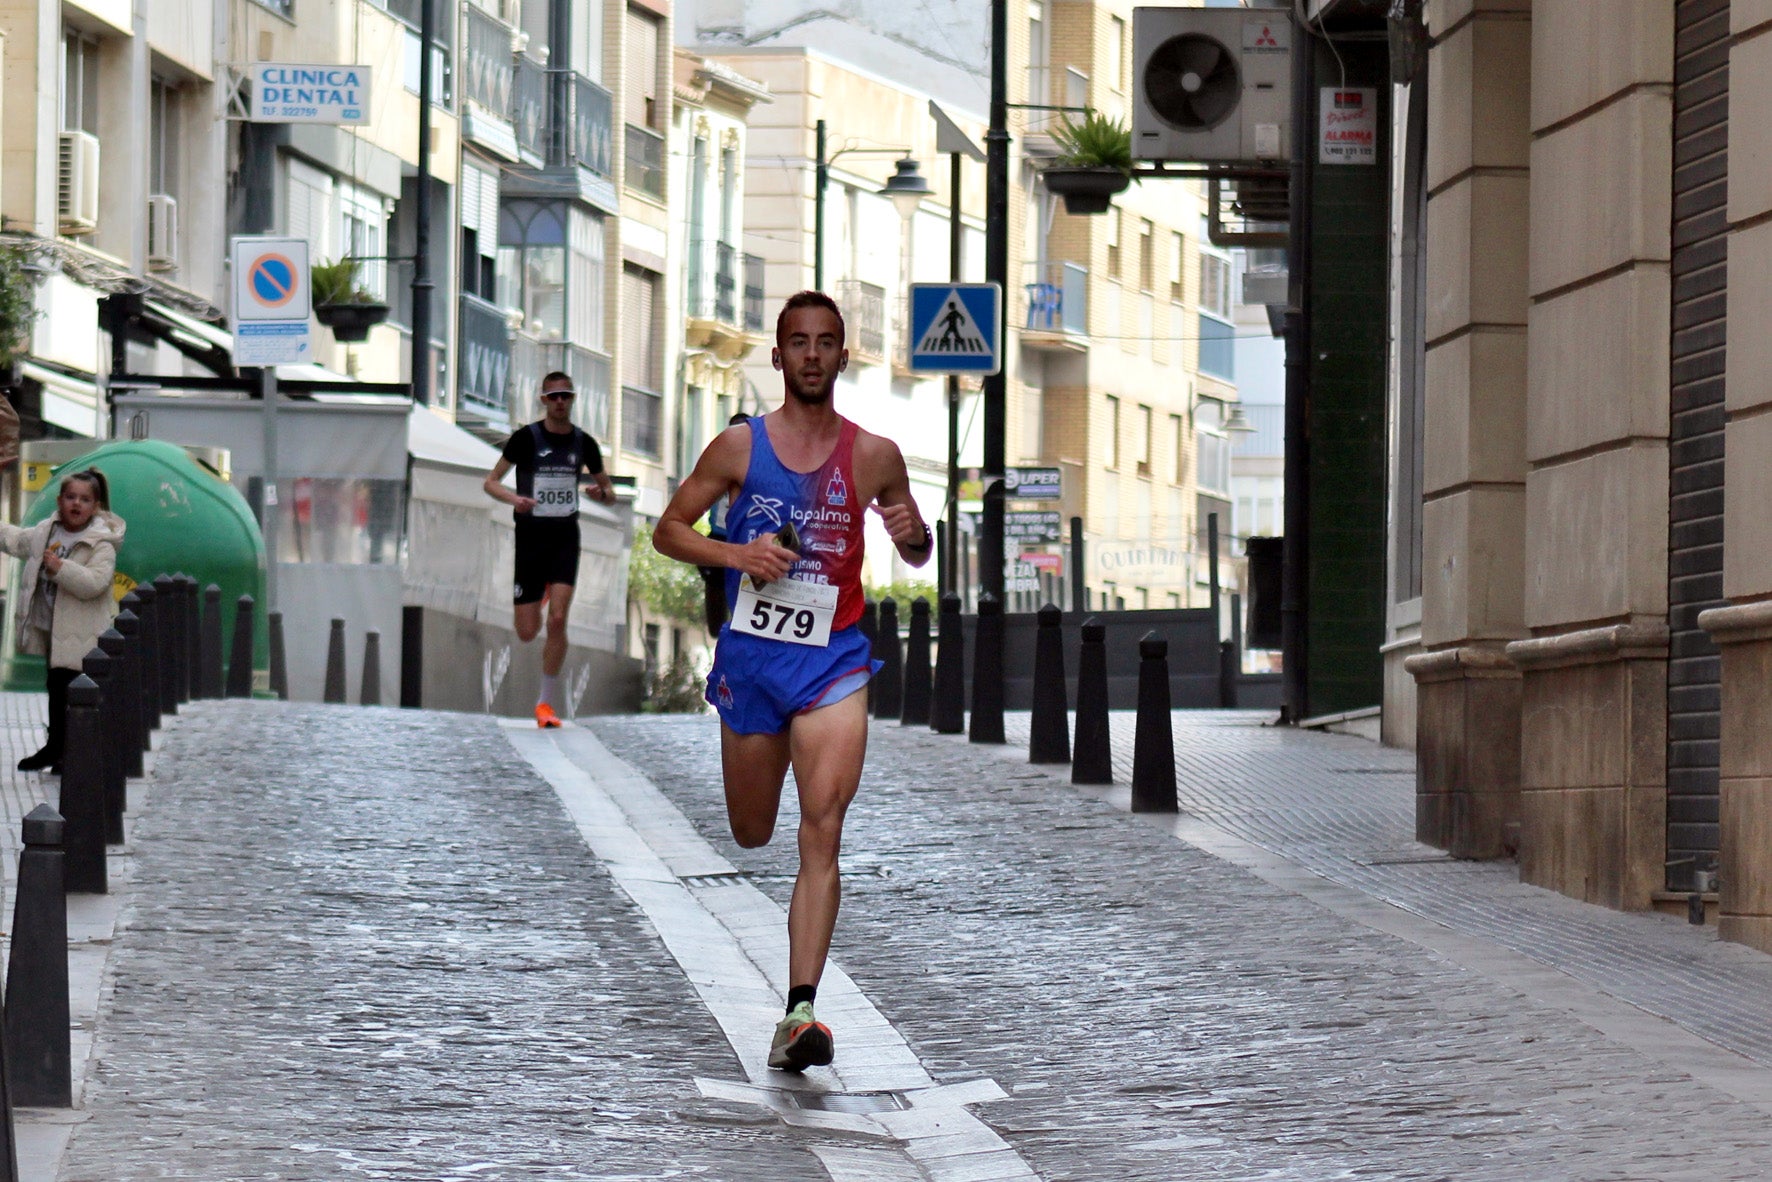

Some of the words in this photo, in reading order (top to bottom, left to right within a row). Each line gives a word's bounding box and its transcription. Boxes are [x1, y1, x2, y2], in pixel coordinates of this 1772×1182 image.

[262, 69, 360, 87] CLINICA
[263, 88, 359, 106] DENTAL
[1326, 131, 1373, 141] ALARMA
[537, 491, 574, 504] 3058
[790, 505, 851, 525] lapalma
[750, 599, 815, 639] 579
